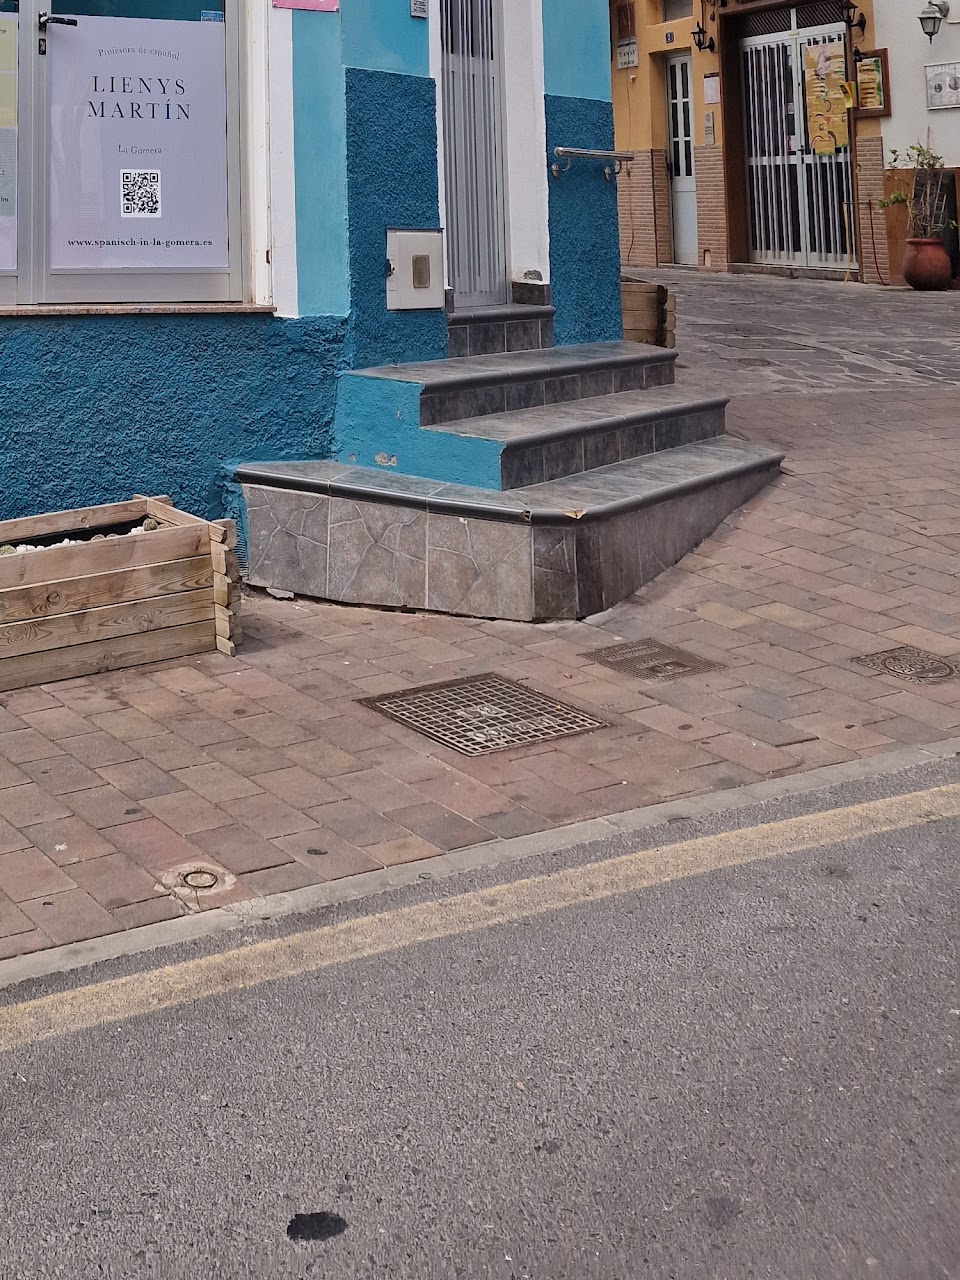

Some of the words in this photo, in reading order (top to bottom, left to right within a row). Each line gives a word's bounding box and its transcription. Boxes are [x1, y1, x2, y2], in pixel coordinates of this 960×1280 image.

[98, 46, 136, 57] Profesora
[138, 47, 147, 55] de
[150, 49, 180, 61] español
[93, 76, 185, 95] LIENYS
[87, 99, 191, 120] MARTÍN
[118, 145, 128, 154] La
[131, 146, 162, 155] Gomera
[68, 237, 213, 248] www.spanisch-in-la-gomera.es
